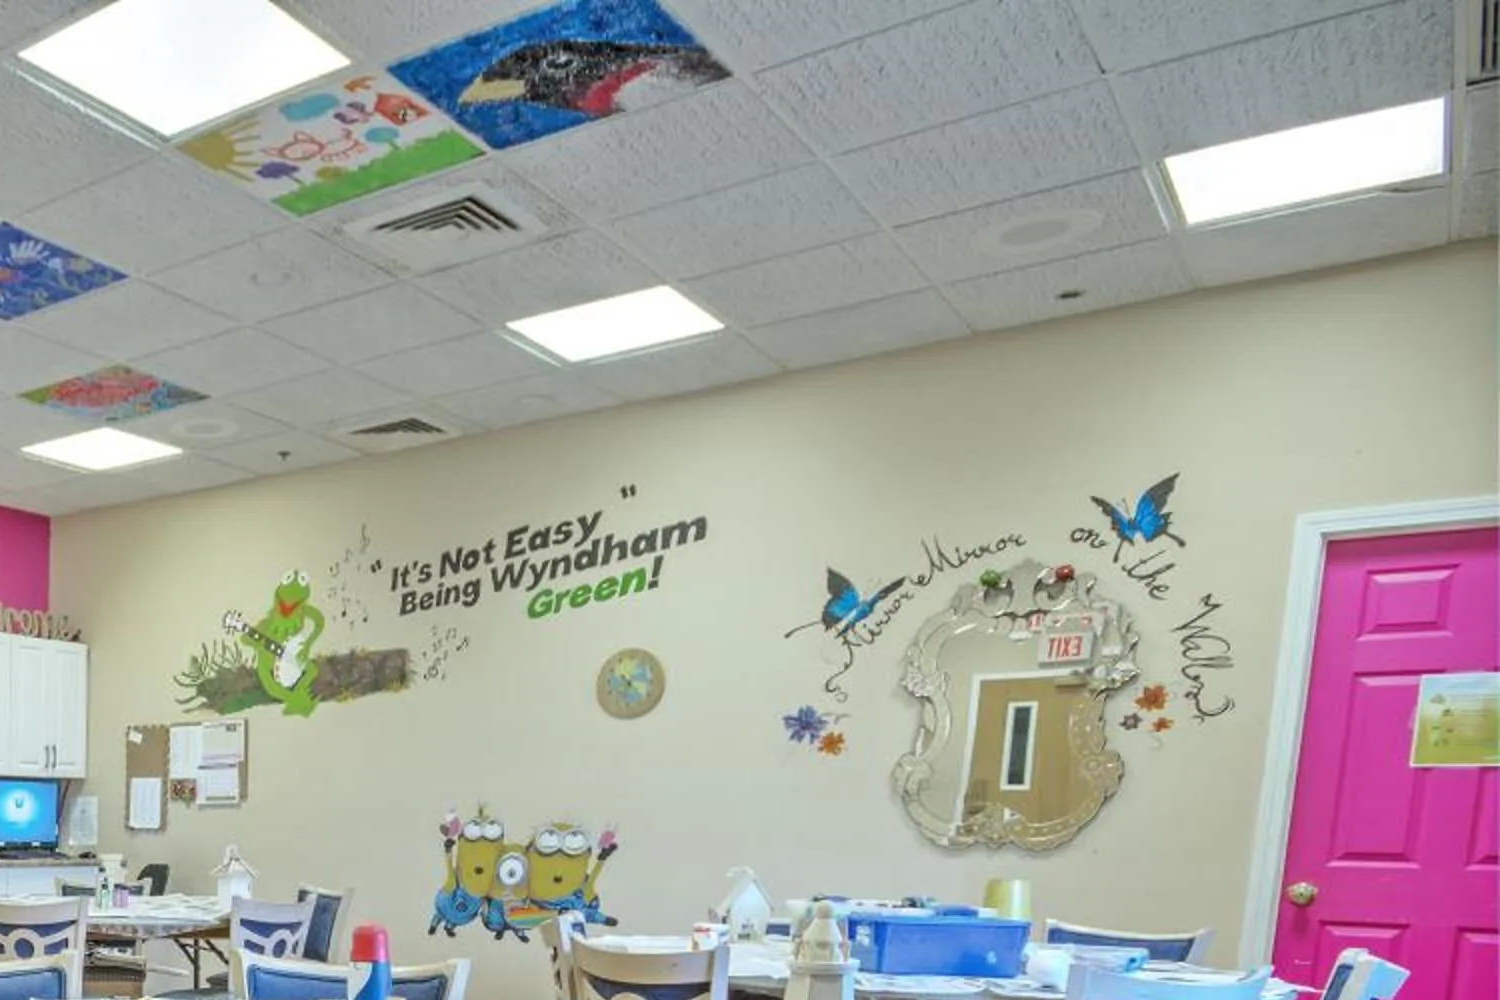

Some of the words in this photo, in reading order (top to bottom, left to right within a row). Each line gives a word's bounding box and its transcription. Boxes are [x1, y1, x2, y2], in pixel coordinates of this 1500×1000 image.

[399, 577, 482, 617] Being
[489, 514, 708, 593] Wyndham
[439, 538, 497, 579] Not
[526, 554, 665, 620] Green!
[911, 534, 1028, 588] Mirror
[1070, 527, 1107, 549] on
[1121, 549, 1176, 601] the
